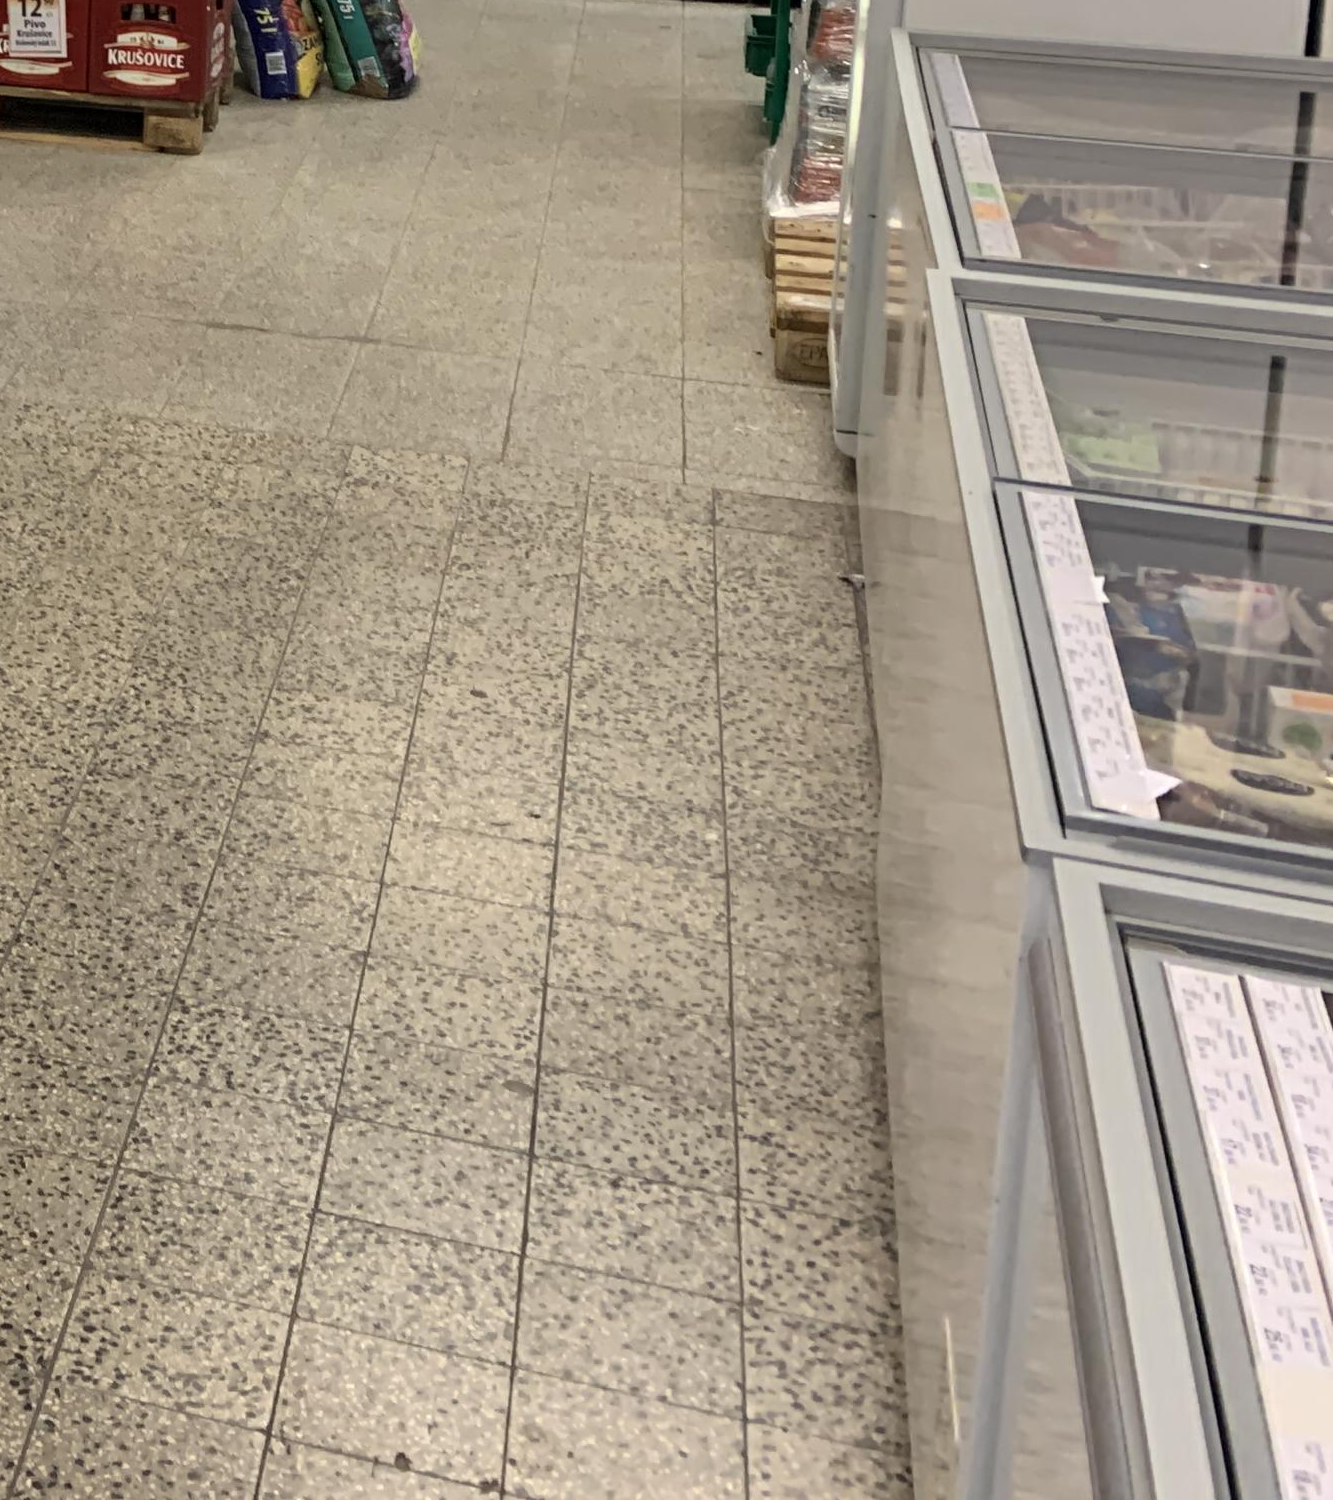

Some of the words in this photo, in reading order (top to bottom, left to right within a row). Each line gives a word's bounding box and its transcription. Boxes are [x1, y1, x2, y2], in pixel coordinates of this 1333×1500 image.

[254, 7, 273, 24] 75
[24, 20, 46, 29] Pivo
[108, 49, 184, 68] KRUŠOVICE
